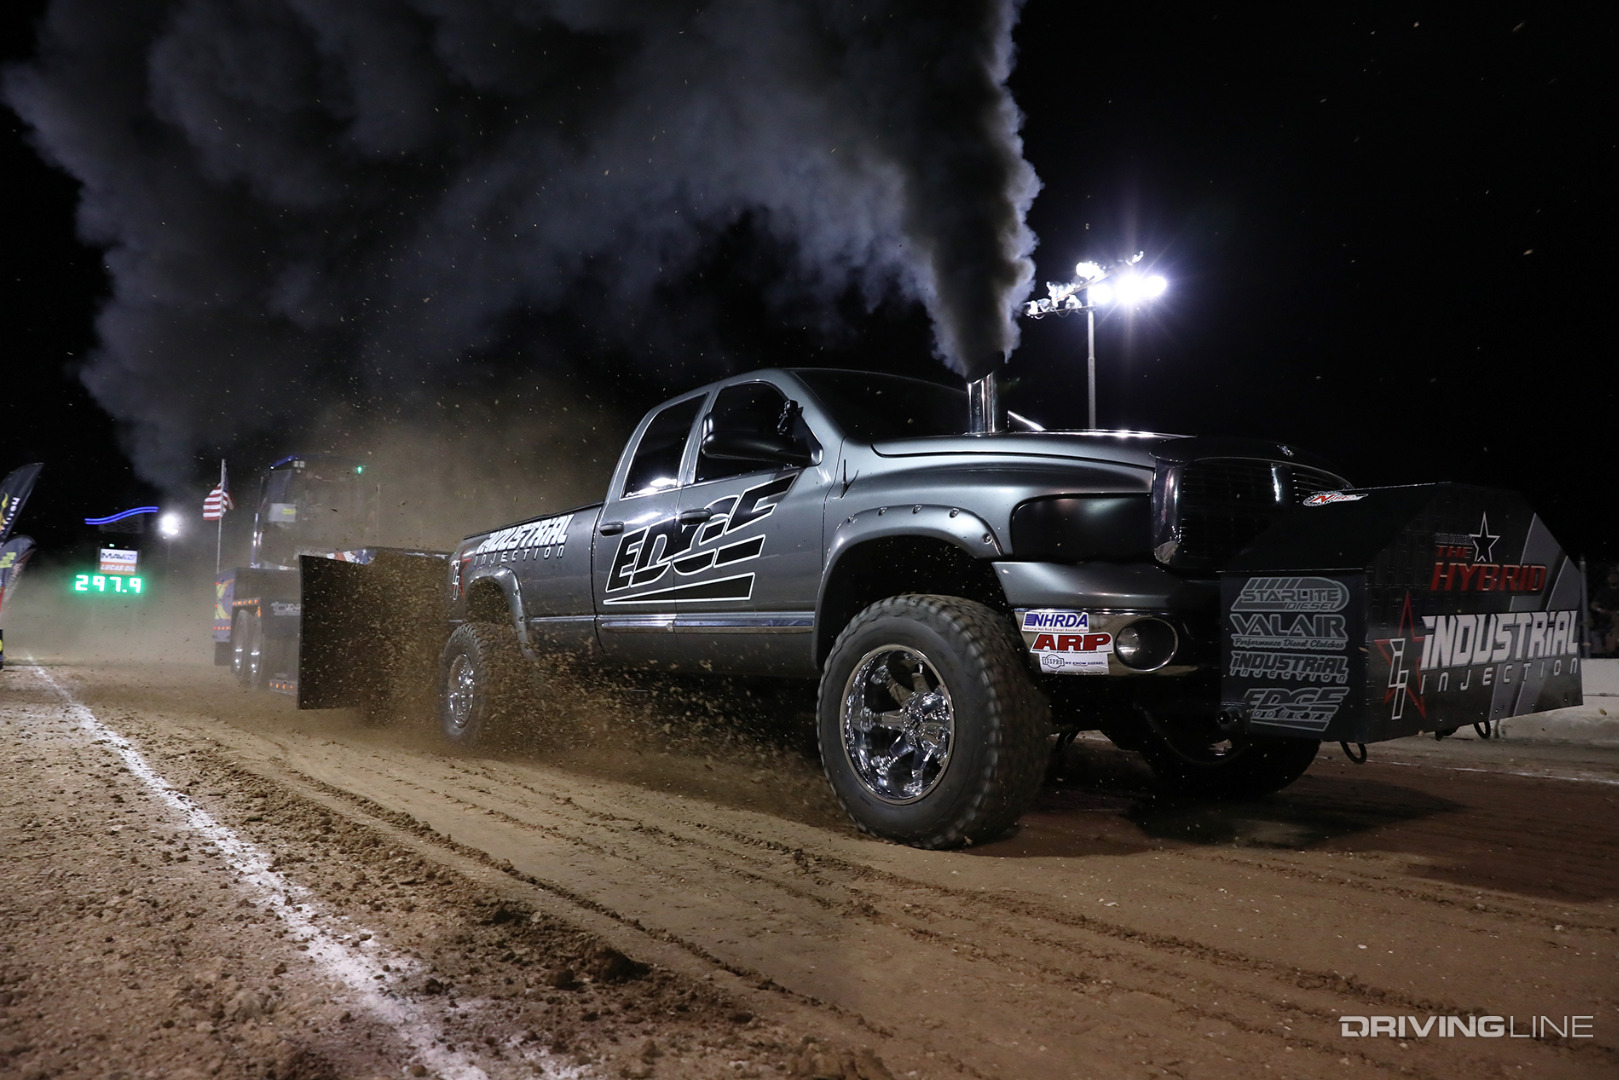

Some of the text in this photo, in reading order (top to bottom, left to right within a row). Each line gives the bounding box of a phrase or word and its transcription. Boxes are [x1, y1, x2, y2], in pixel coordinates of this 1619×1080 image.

[606, 472, 800, 593] EDGE
[1436, 545, 1473, 559] THE
[75, 574, 143, 594] 297.9
[1430, 562, 1547, 592] HYBRID
[1241, 589, 1340, 602] STARLITE
[1285, 602, 1339, 611] DIESEL
[1032, 612, 1088, 628] NHRDA
[1230, 614, 1348, 638] VALAIR
[1032, 633, 1112, 651] ARP
[1234, 638, 1344, 648] Performance Diesel Clutches
[1252, 710, 1333, 720] ODUCTS
